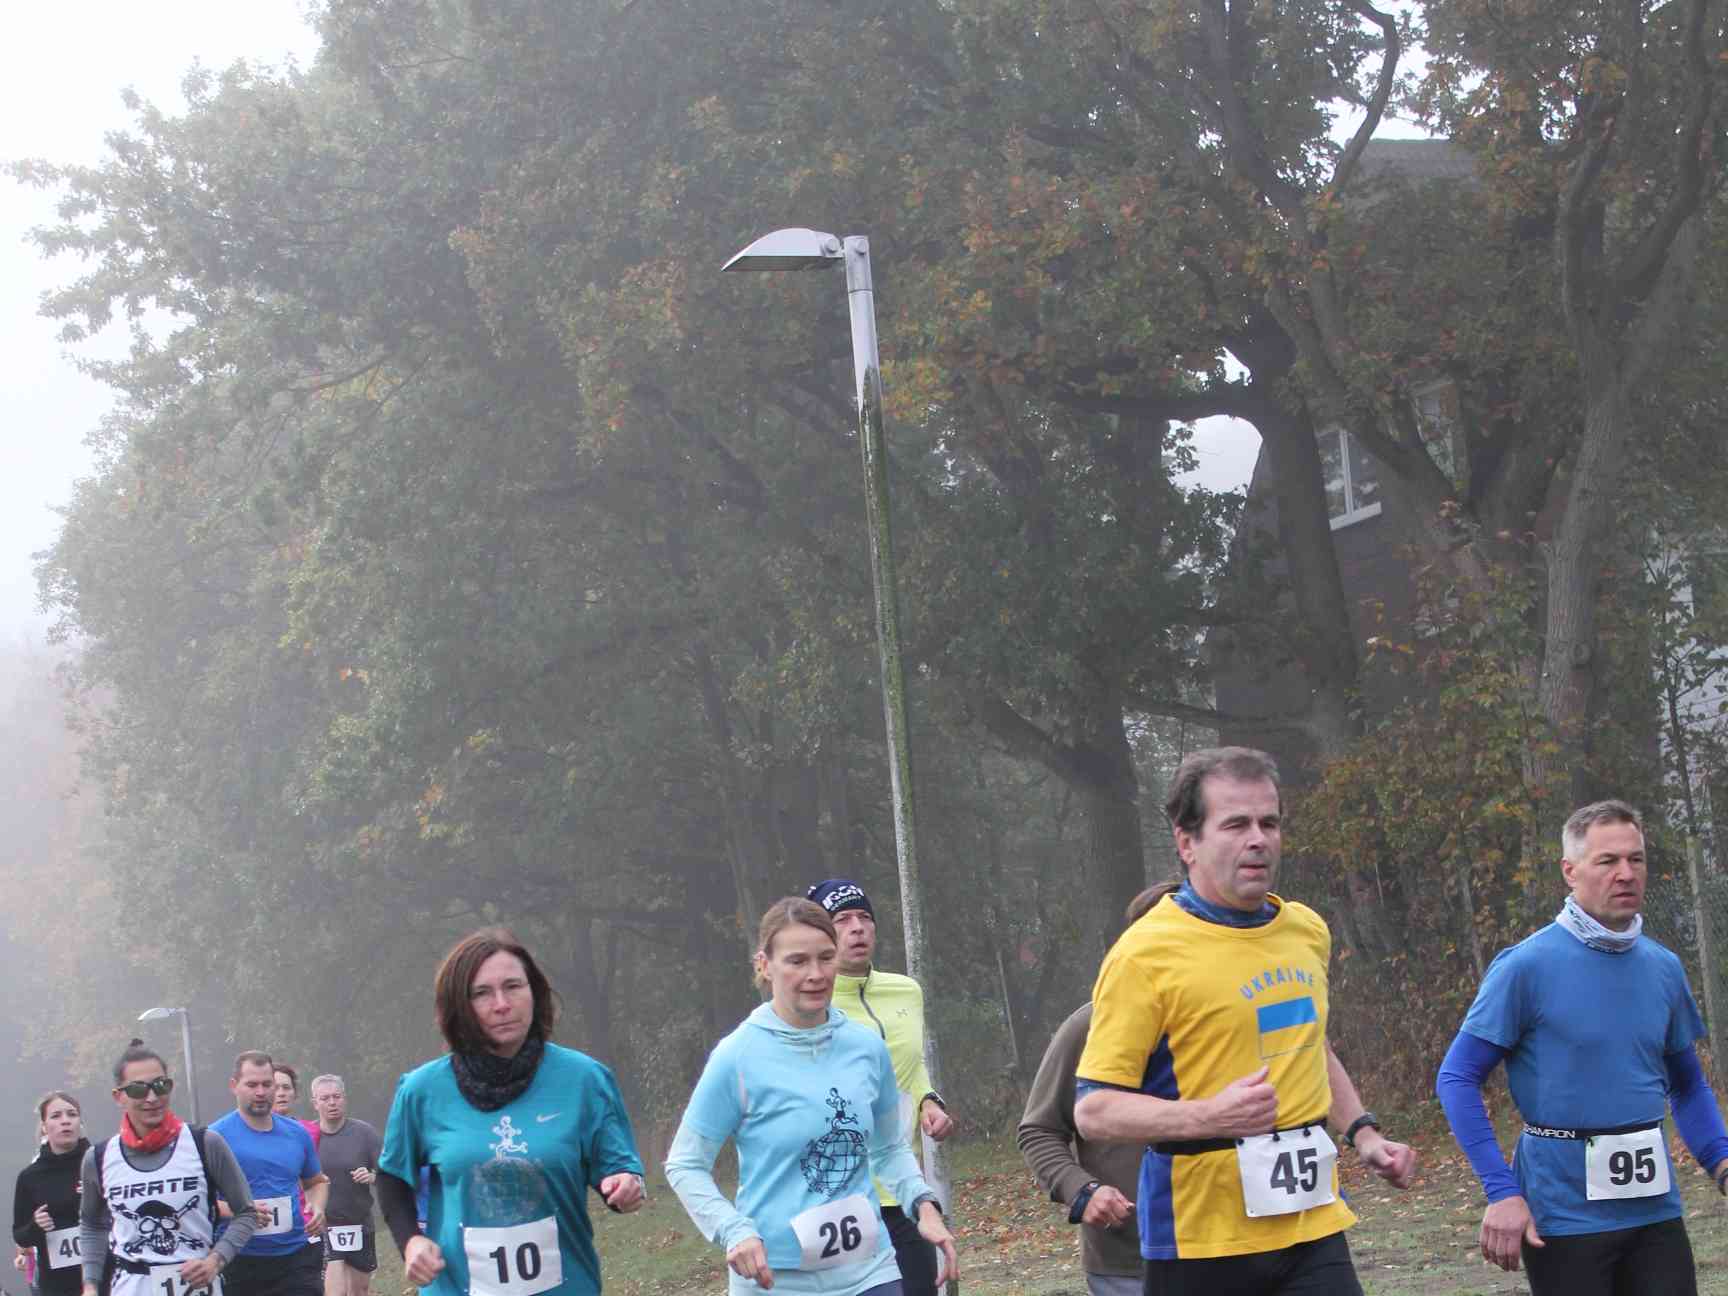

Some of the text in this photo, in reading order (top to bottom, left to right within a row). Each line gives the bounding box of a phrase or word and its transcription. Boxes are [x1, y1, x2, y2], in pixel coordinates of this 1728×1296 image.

[1270, 1147, 1318, 1194] 45
[1609, 1147, 1656, 1185] 95
[109, 1176, 199, 1199] PIRATE
[337, 1231, 356, 1246] 67
[819, 1215, 862, 1258] 26
[489, 1242, 541, 1284] 10
